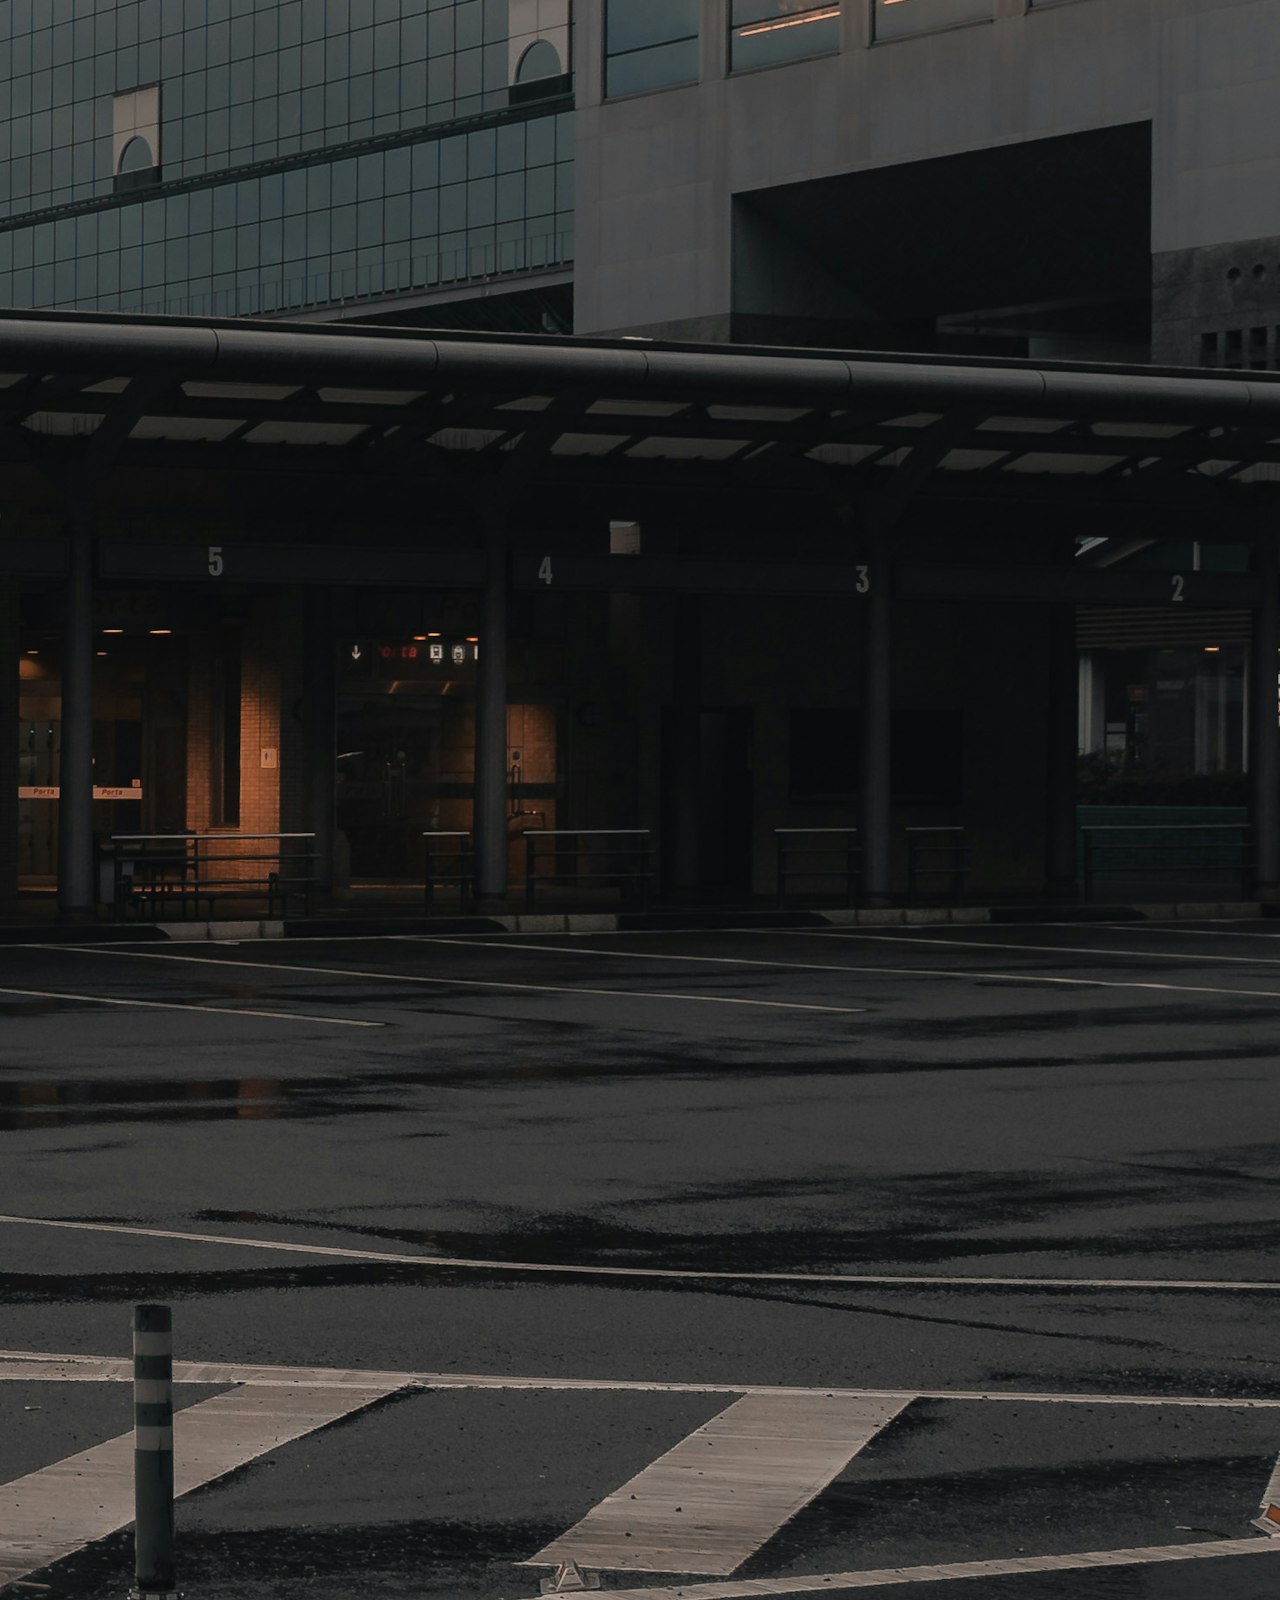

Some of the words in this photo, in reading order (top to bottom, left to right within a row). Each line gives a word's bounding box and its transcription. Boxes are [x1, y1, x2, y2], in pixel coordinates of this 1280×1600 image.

[208, 547, 223, 576] 5
[538, 556, 553, 585] 4
[856, 565, 869, 593] 3
[1172, 575, 1184, 602] 2
